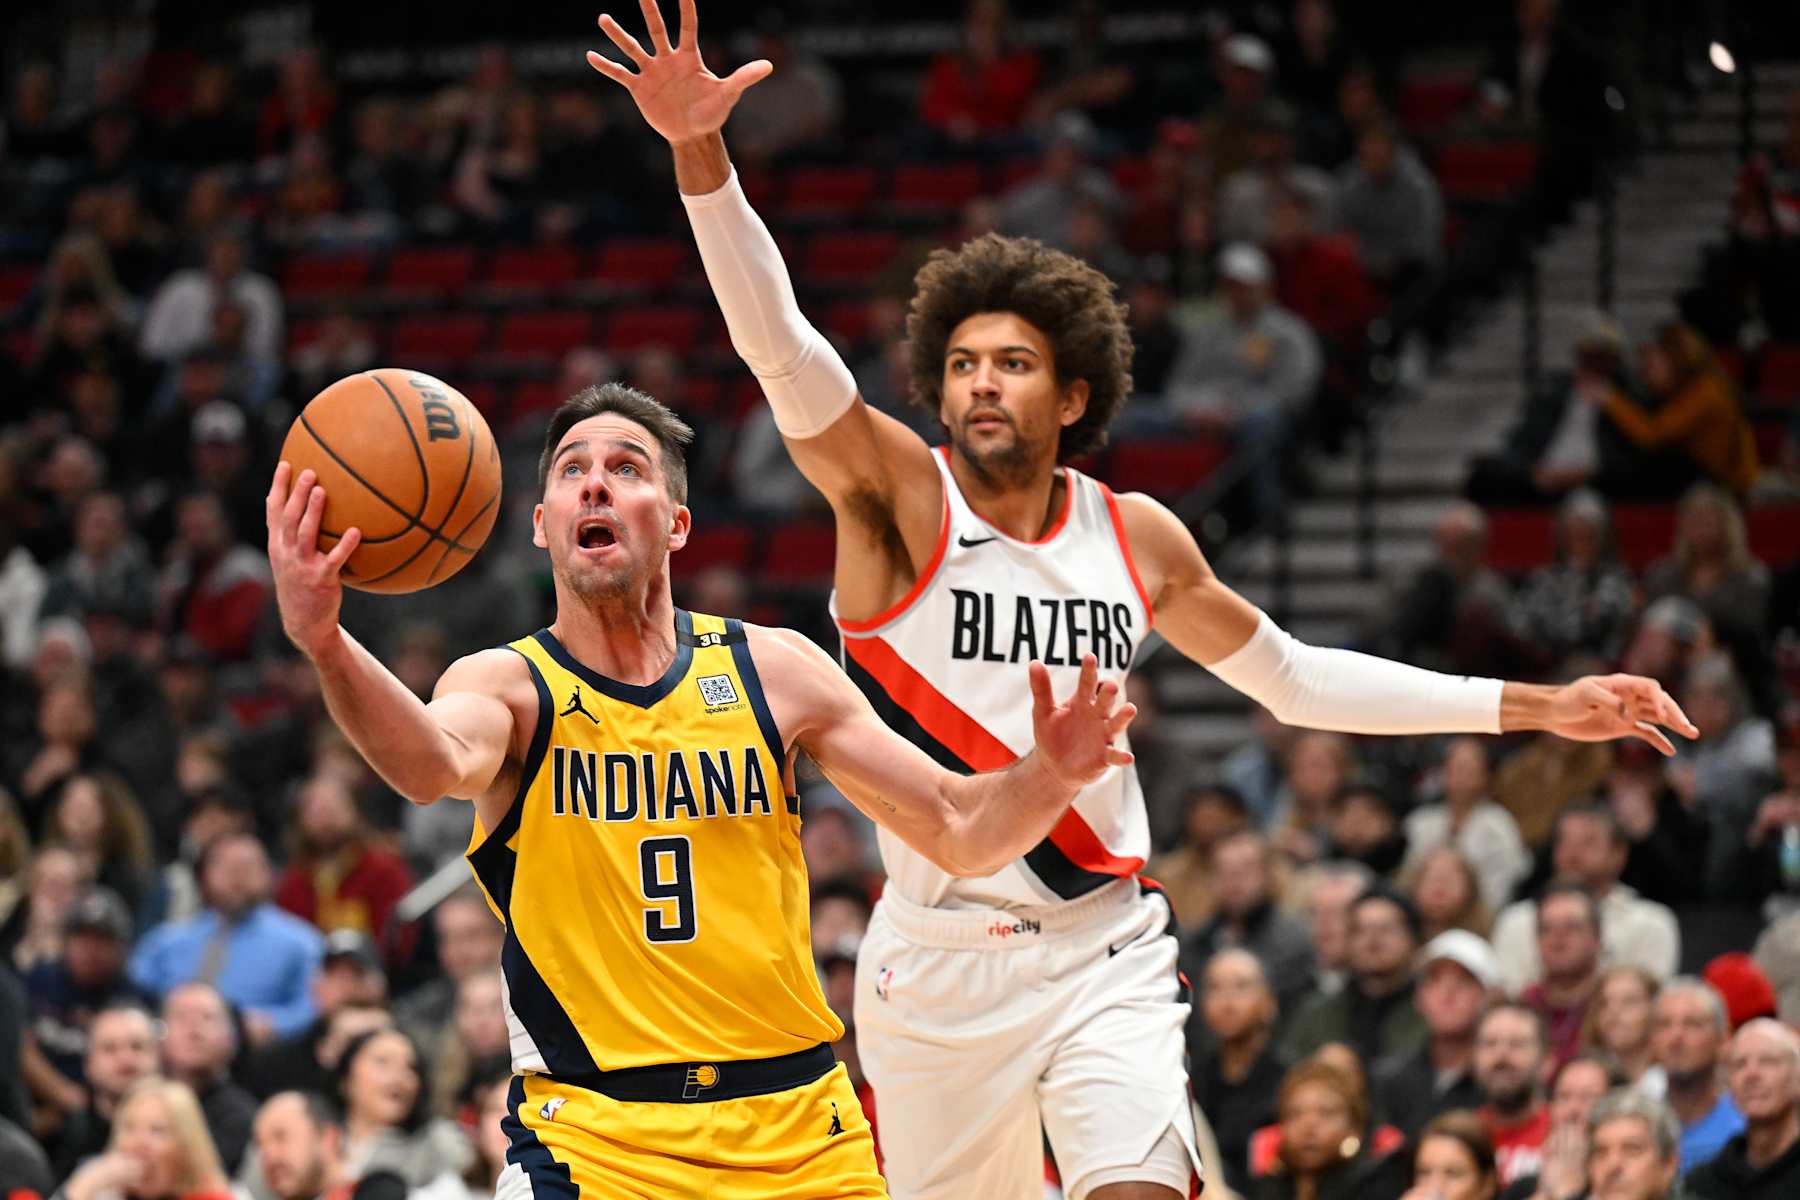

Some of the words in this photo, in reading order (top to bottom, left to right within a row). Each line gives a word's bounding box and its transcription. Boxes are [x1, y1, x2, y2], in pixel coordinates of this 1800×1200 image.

[700, 633, 721, 647] 30
[950, 588, 1132, 670] BLAZERS
[552, 745, 772, 823] INDIANA
[638, 834, 698, 945] 9
[988, 919, 1041, 938] ripcity
